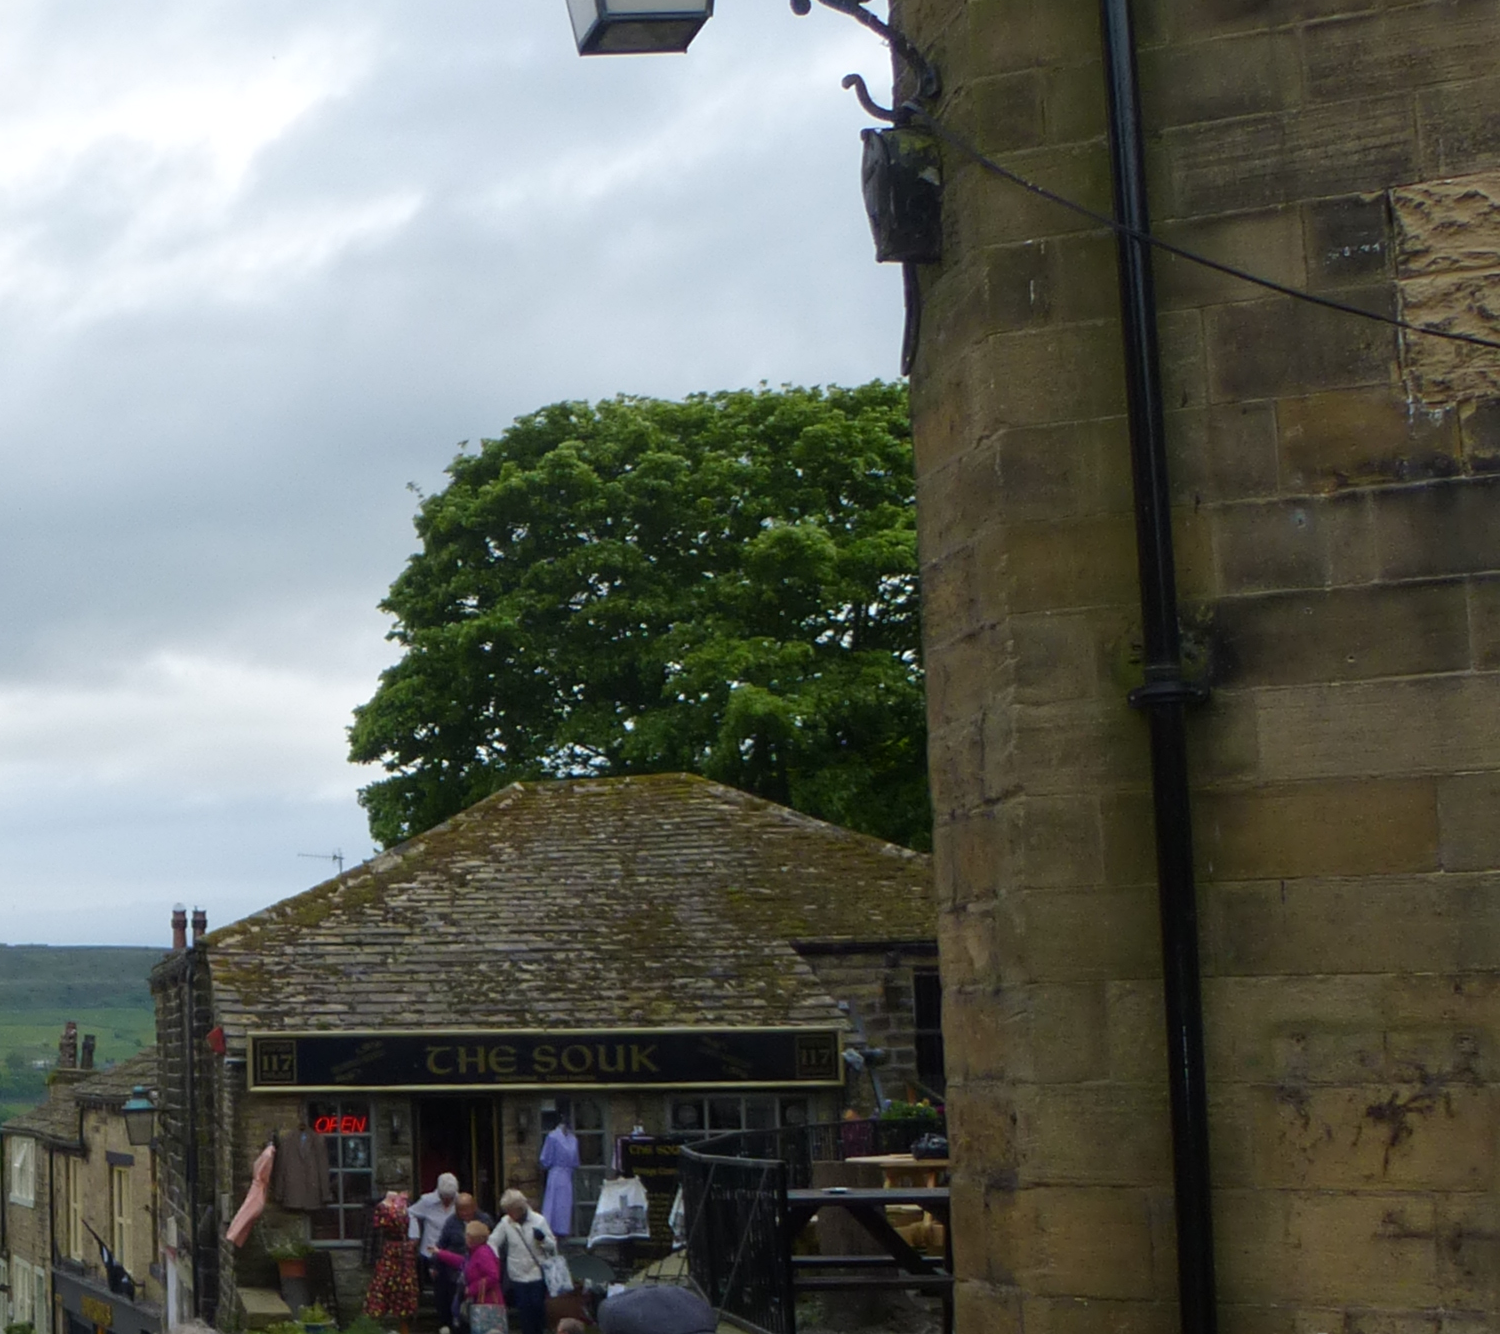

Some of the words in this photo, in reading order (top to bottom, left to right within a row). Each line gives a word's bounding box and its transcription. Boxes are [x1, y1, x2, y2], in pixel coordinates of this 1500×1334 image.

[262, 1054, 293, 1071] 117
[426, 1045, 517, 1075] THE
[532, 1044, 660, 1073] SOUK
[801, 1048, 830, 1066] 117
[314, 1114, 368, 1134] OPEN
